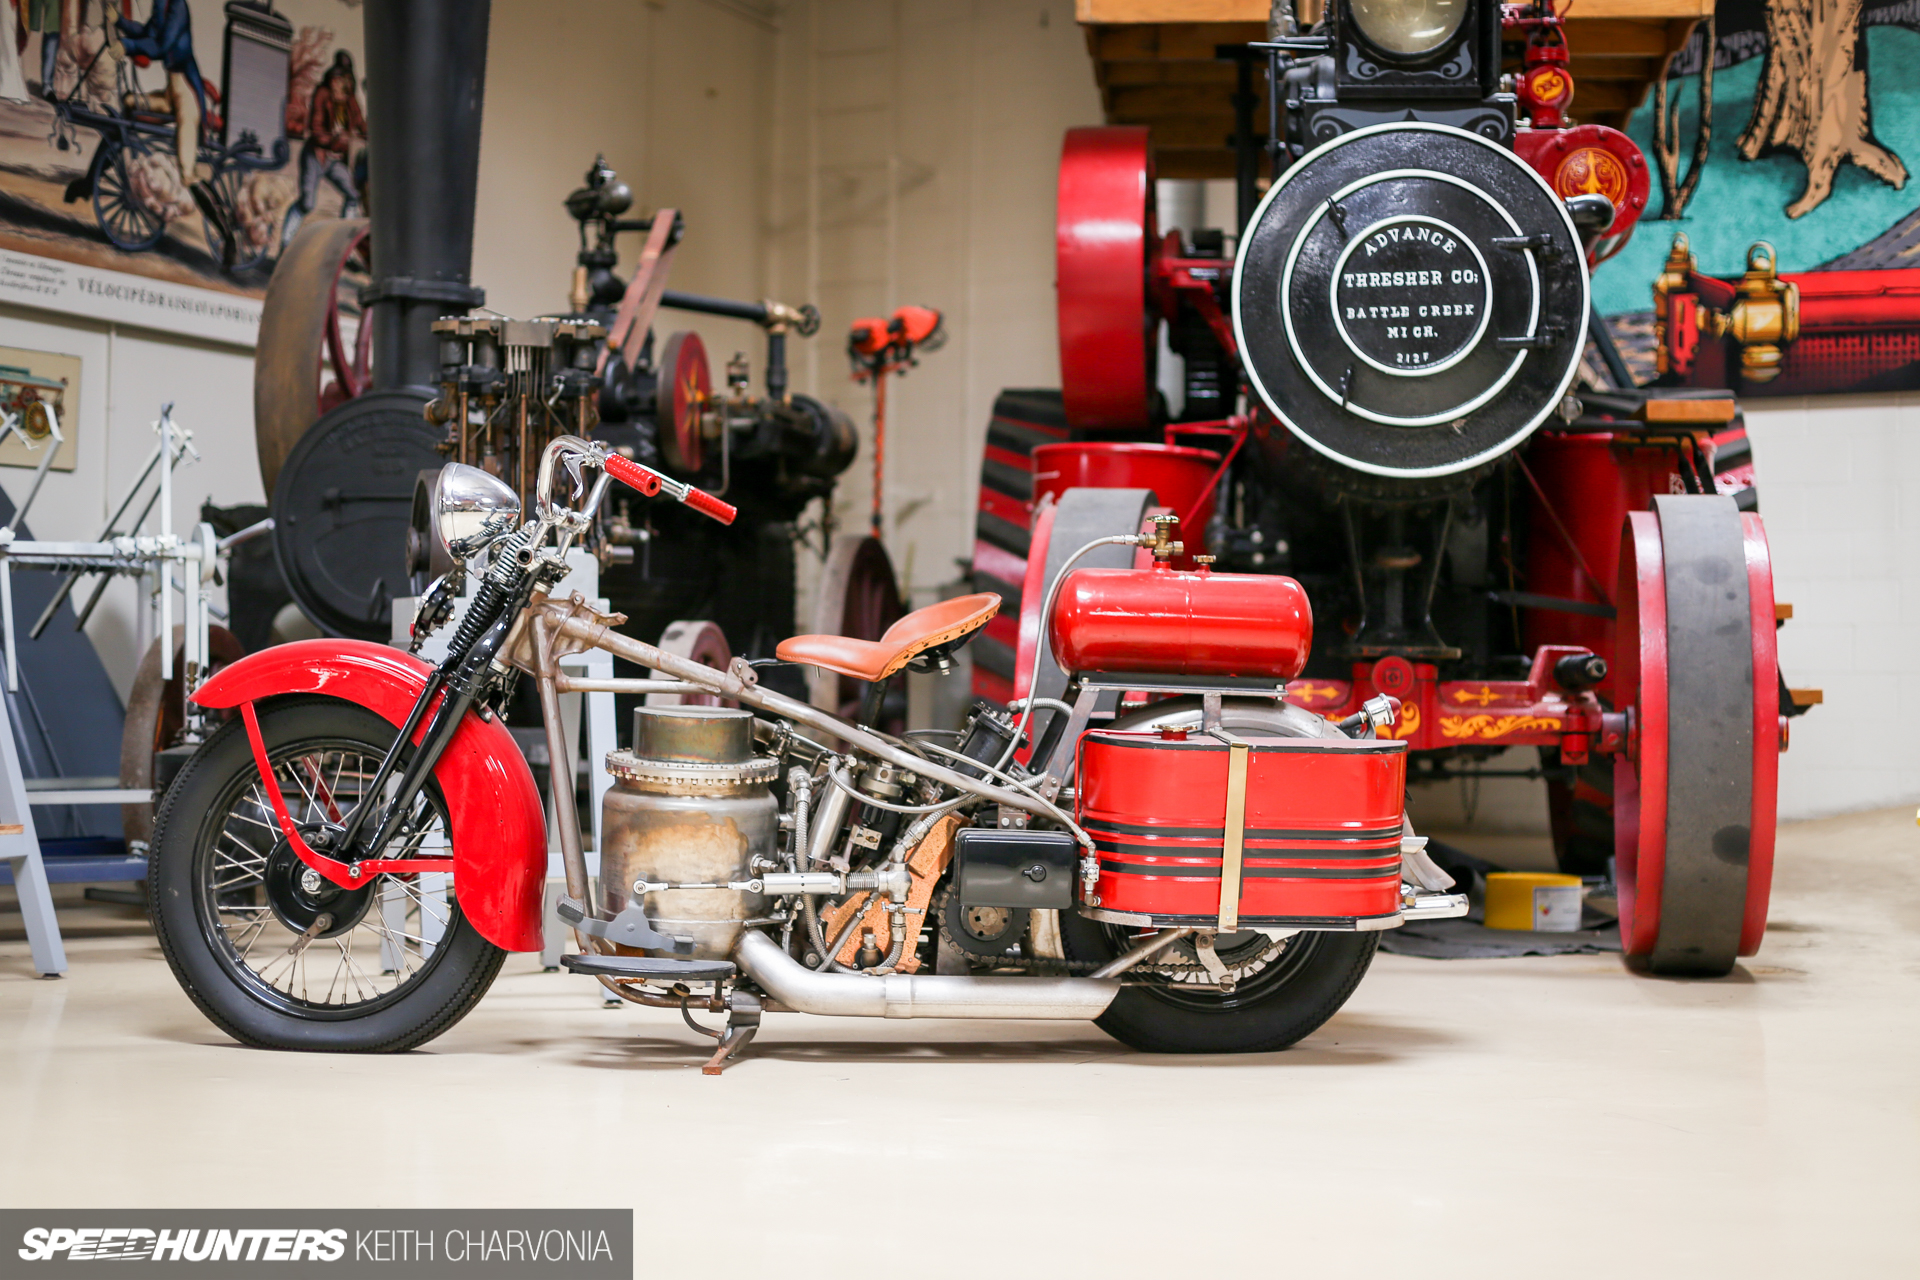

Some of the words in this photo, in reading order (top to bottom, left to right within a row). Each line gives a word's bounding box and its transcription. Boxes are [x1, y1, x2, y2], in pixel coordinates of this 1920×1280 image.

[1364, 226, 1457, 257] ADVANCE
[1344, 270, 1443, 288] THRESHER
[1346, 306, 1410, 319] BATTLE
[1419, 304, 1475, 317] CREEK
[1387, 325, 1438, 339] MICH.
